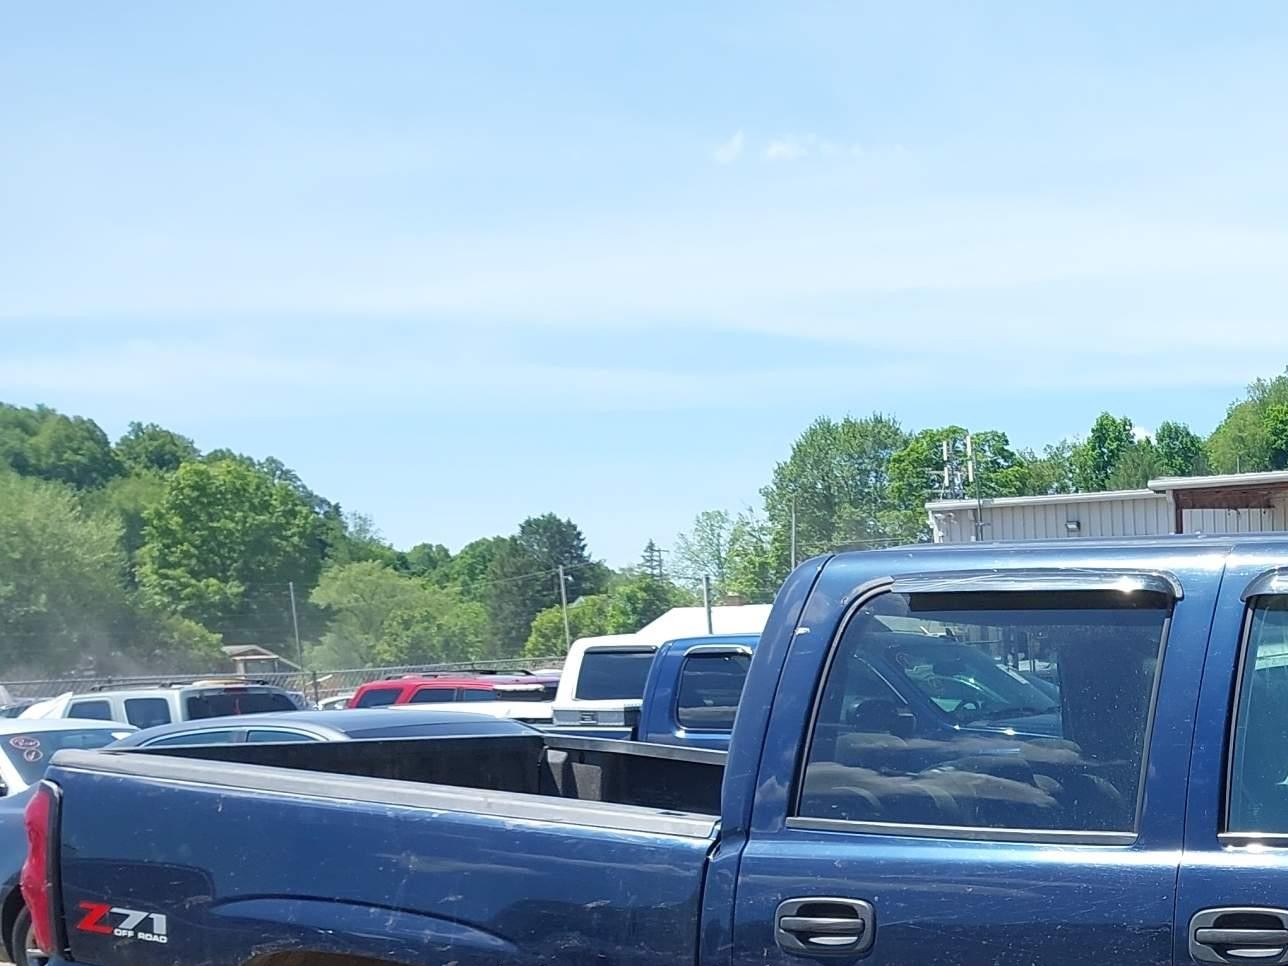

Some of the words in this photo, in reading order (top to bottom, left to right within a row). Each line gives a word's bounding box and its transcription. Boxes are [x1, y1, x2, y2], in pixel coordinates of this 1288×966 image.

[76, 902, 168, 935] Z71
[113, 928, 135, 938] OFF
[137, 932, 168, 944] ROAD
